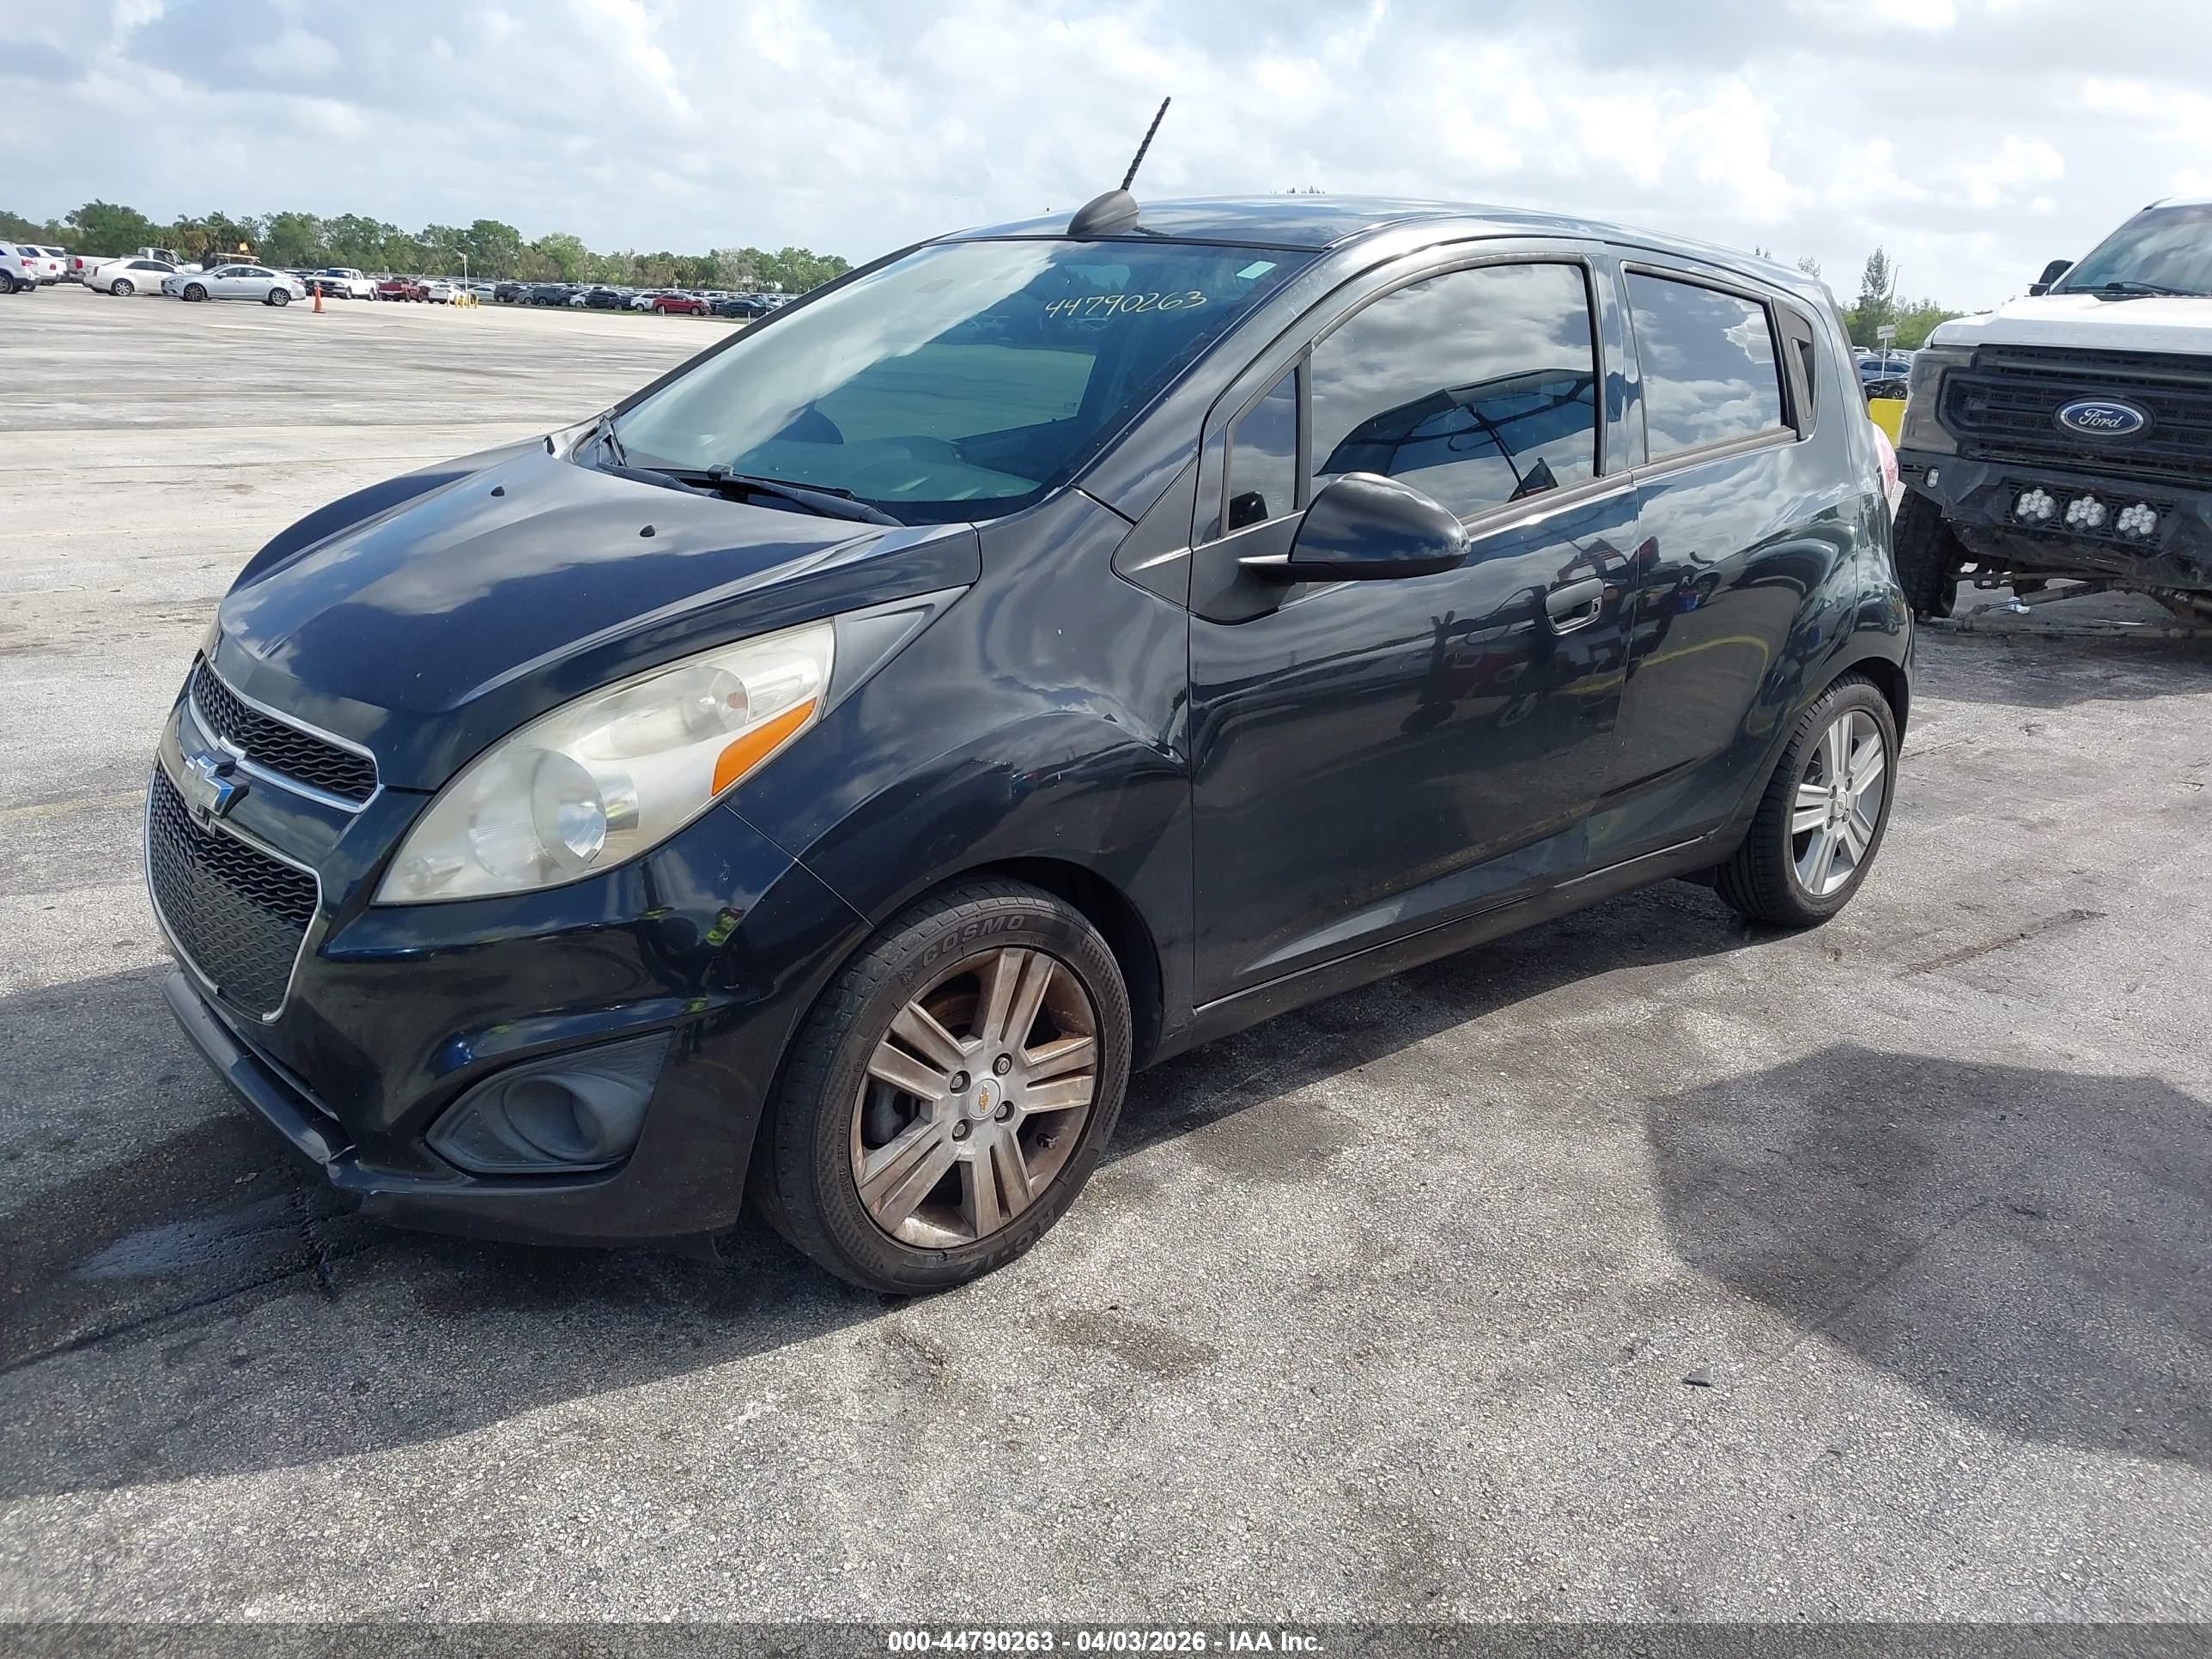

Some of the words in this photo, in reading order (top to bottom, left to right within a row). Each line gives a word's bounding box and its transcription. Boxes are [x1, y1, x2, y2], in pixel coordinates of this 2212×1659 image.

[1044, 289, 1208, 319] 44790263
[2078, 408, 2124, 428] Ford
[921, 915, 1025, 968] COSMO
